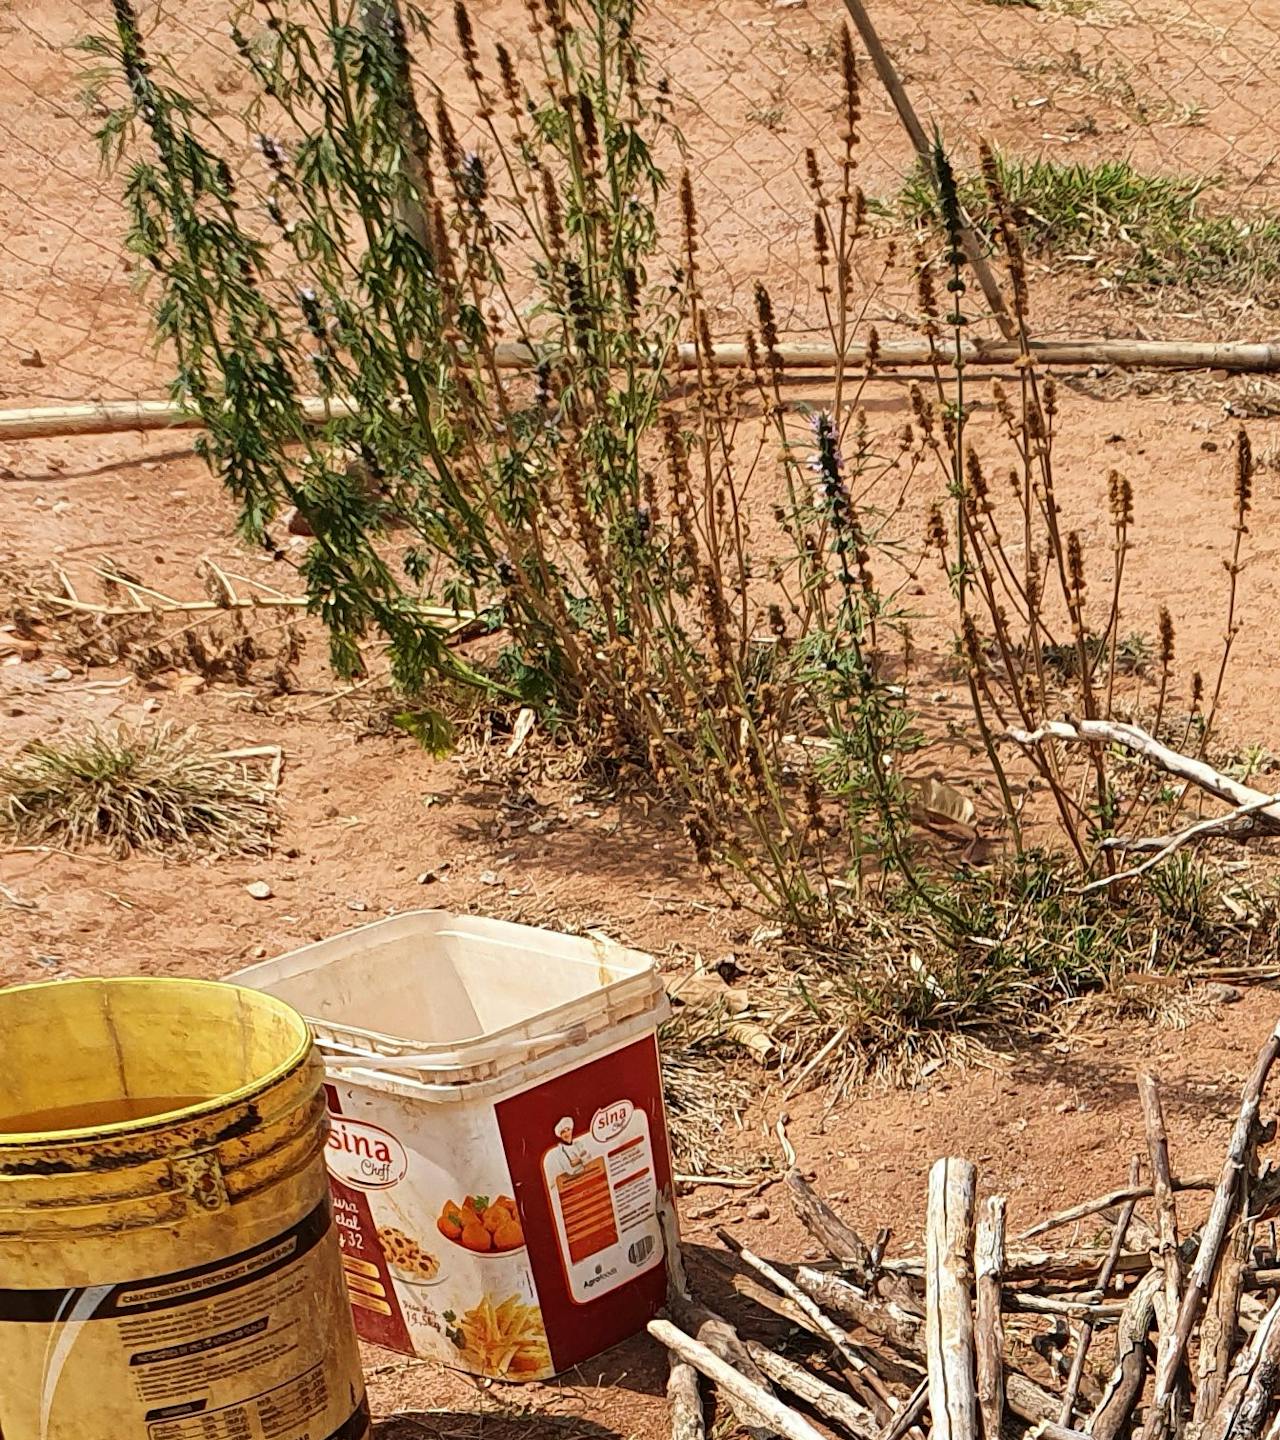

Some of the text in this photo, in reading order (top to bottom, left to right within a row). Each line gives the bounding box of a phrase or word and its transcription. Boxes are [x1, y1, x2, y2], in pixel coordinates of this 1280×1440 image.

[598, 1106, 626, 1130] sina
[327, 1124, 393, 1164] sina
[335, 1212, 361, 1231] etal
[348, 1230, 365, 1250] 32
